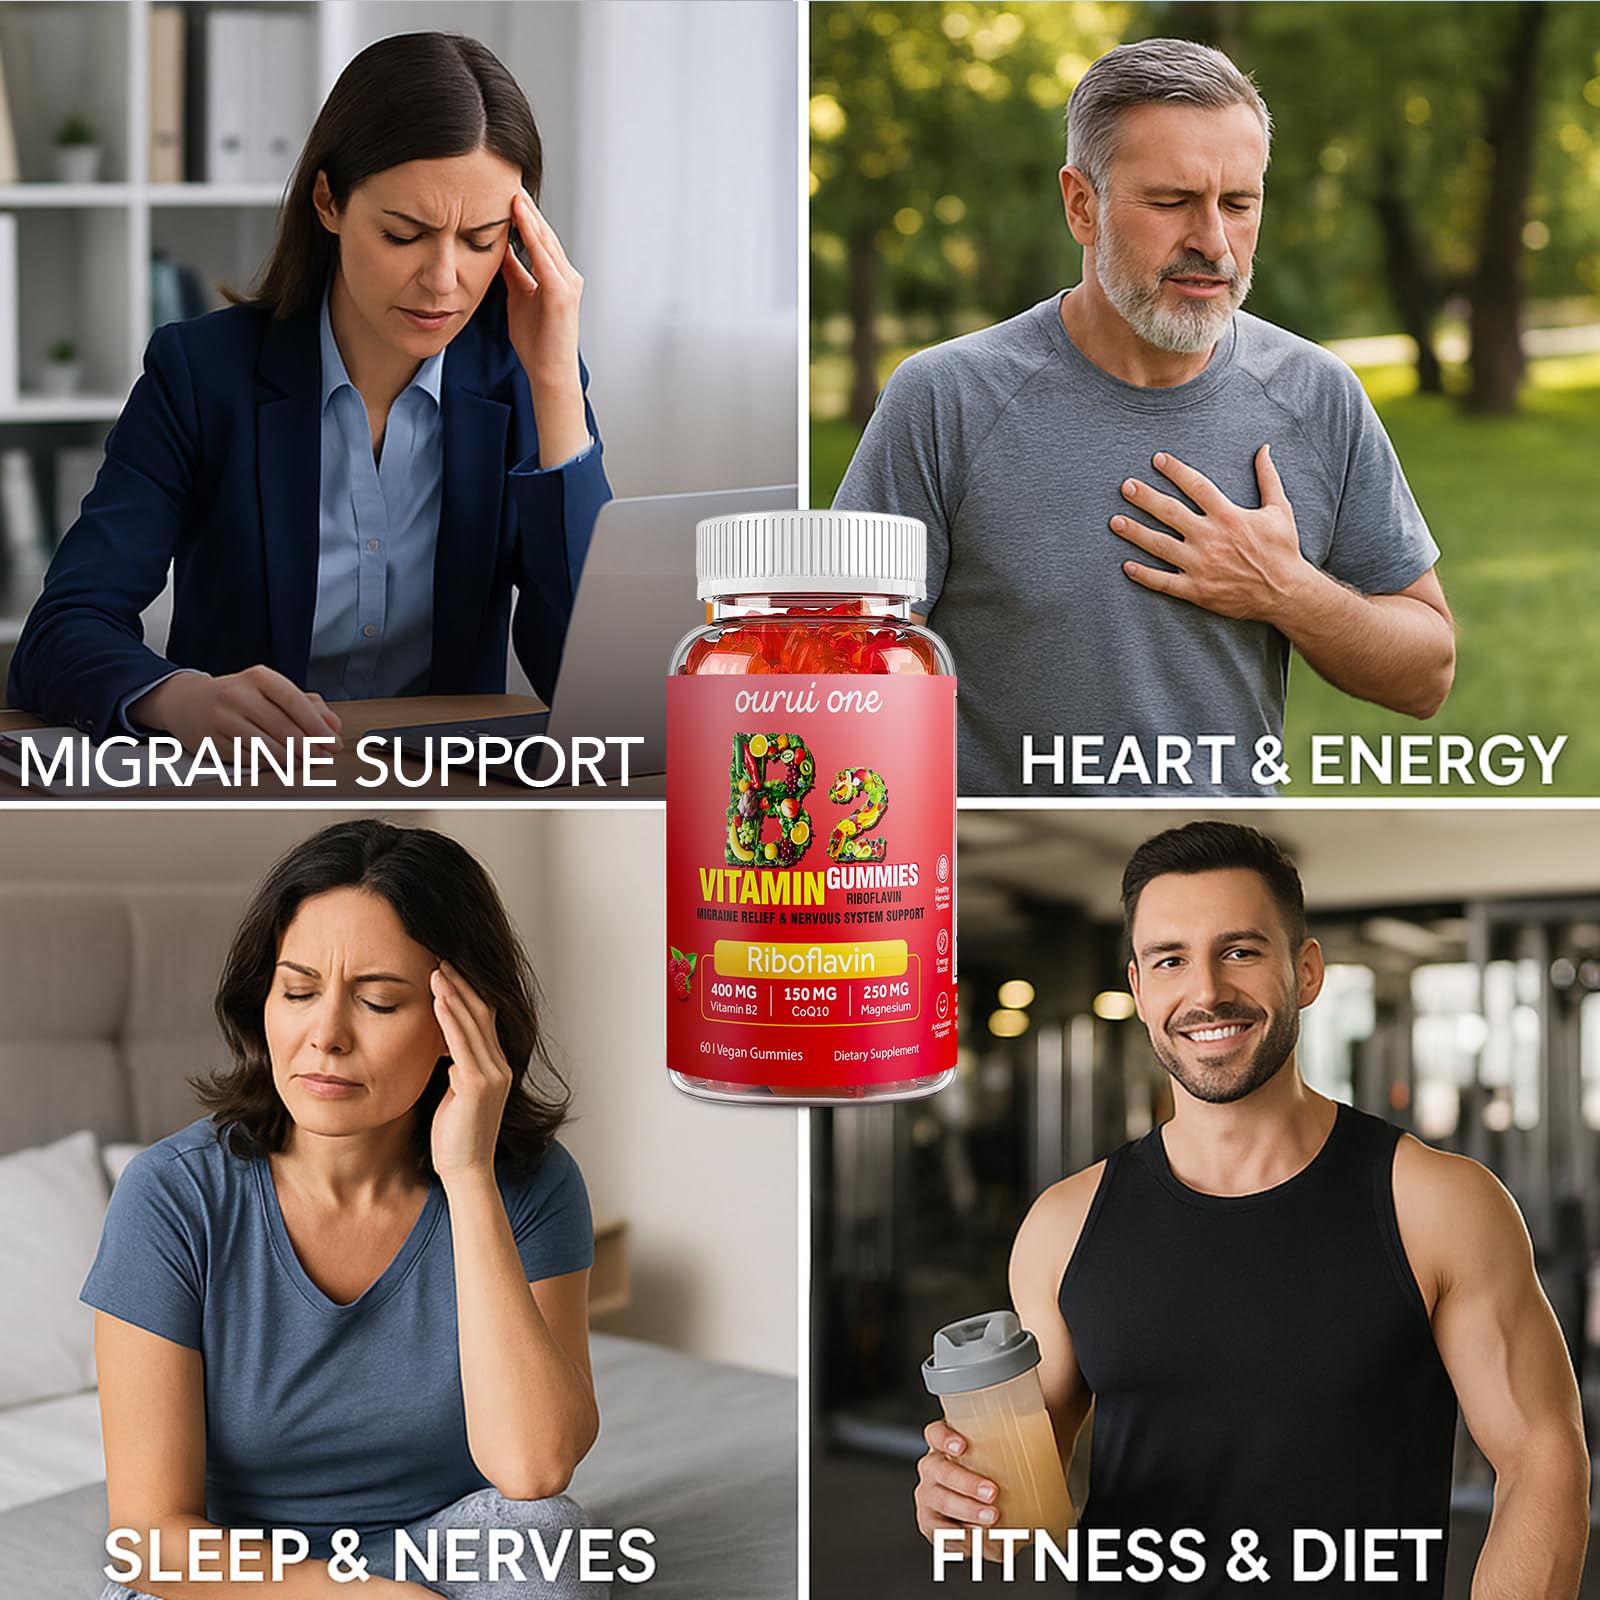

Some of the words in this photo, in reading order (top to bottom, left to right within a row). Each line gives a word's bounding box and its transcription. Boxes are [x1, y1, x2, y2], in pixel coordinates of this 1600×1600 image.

[735, 682, 819, 713] ourui
[826, 689, 884, 713] one
[699, 867, 825, 906] VITAMIN
[826, 863, 919, 890] GUMMIES
[846, 890, 902, 905] RIBOFLAVIN
[696, 908, 739, 923] MIGRAINE
[741, 910, 776, 924] RELIEF
[779, 912, 787, 924] &
[790, 912, 841, 925] NERVOUS
[843, 910, 883, 924] SYSTEM
[886, 907, 925, 922] SUPPORT
[747, 946, 875, 975] Riboflavin
[711, 982, 733, 998] 400
[735, 985, 757, 999] MG
[784, 987, 810, 1001] 150
[813, 986, 837, 1001] MG
[863, 985, 888, 999] 250
[889, 982, 909, 998] MG
[710, 1001, 744, 1014] Vitamin
[745, 1003, 758, 1015] B2
[792, 1006, 829, 1018] CoQ10
[861, 1002, 912, 1017] Magnesium
[700, 1041, 711, 1054] 60
[717, 1043, 748, 1061] Vegan
[750, 1046, 803, 1061] Gummies
[834, 1049, 869, 1063] Dietary
[870, 1043, 920, 1060] Supplement
